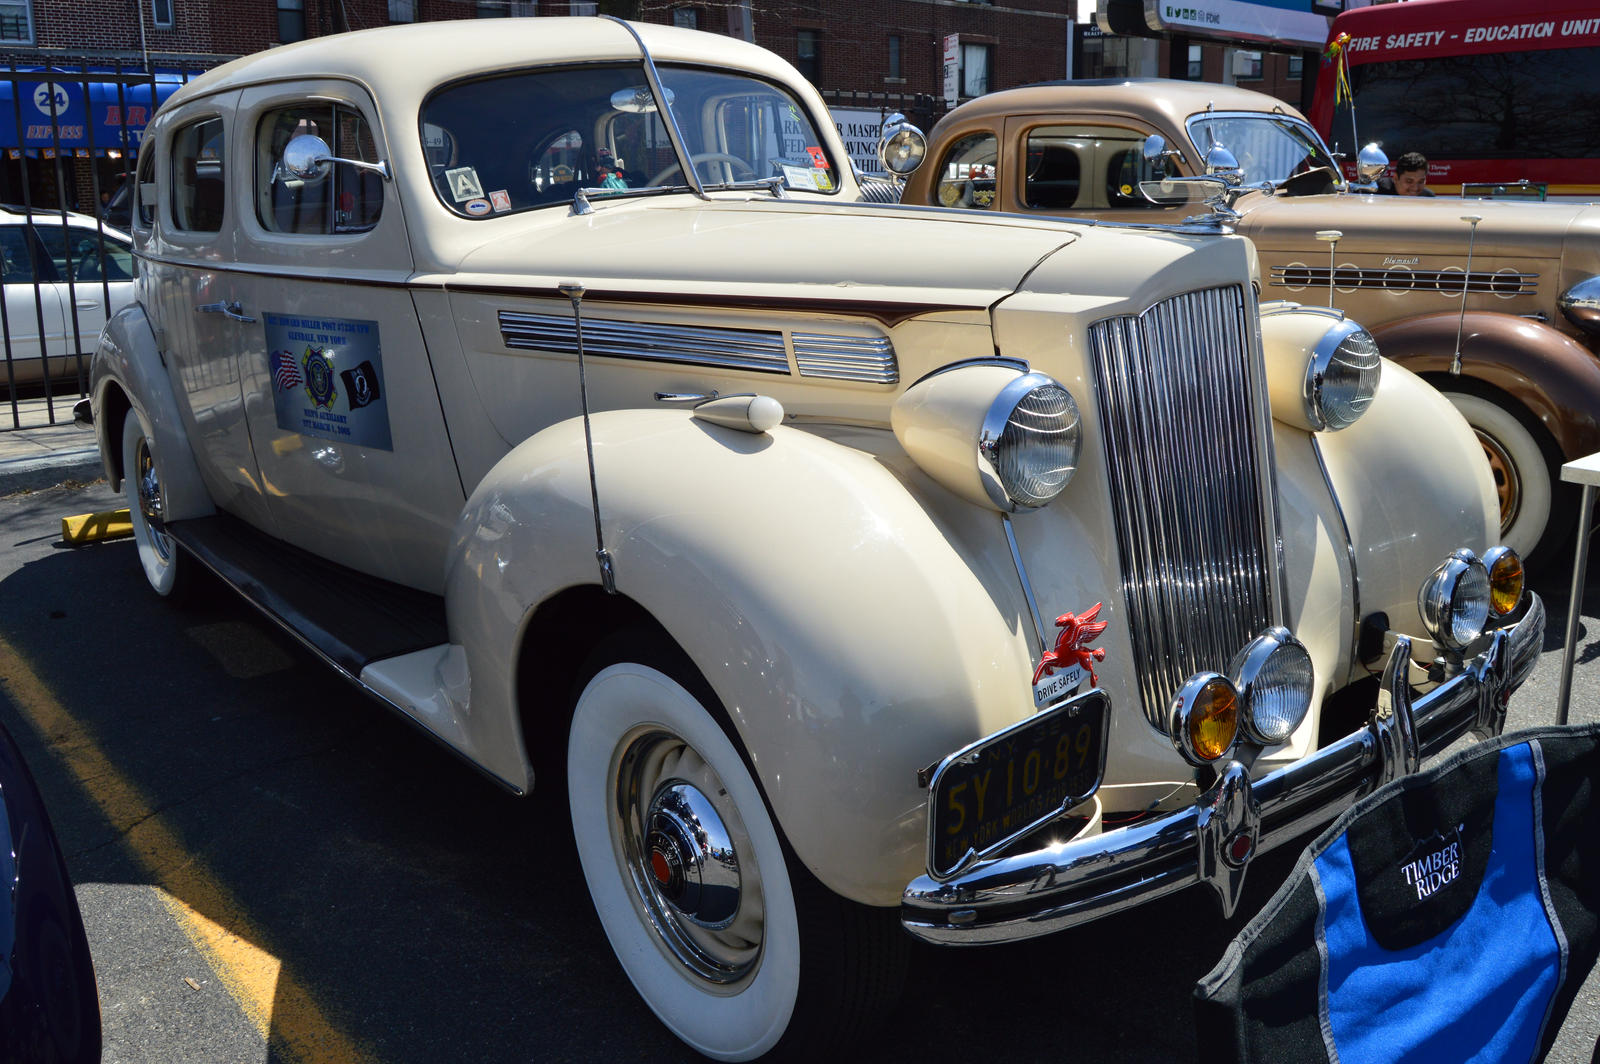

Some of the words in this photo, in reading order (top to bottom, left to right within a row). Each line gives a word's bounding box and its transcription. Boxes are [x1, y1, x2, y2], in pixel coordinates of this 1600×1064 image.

[1348, 37, 1381, 52] FIRE
[1385, 31, 1446, 49] SAFETY
[1560, 18, 1600, 39] UNIT
[38, 92, 66, 107] 24
[26, 125, 83, 139] EXPESS
[456, 174, 479, 197] A
[1037, 682, 1057, 701] DRIVE
[1059, 669, 1081, 689] SAFELY
[1401, 842, 1459, 885] TIMBER
[1415, 860, 1460, 900] RIDGE
